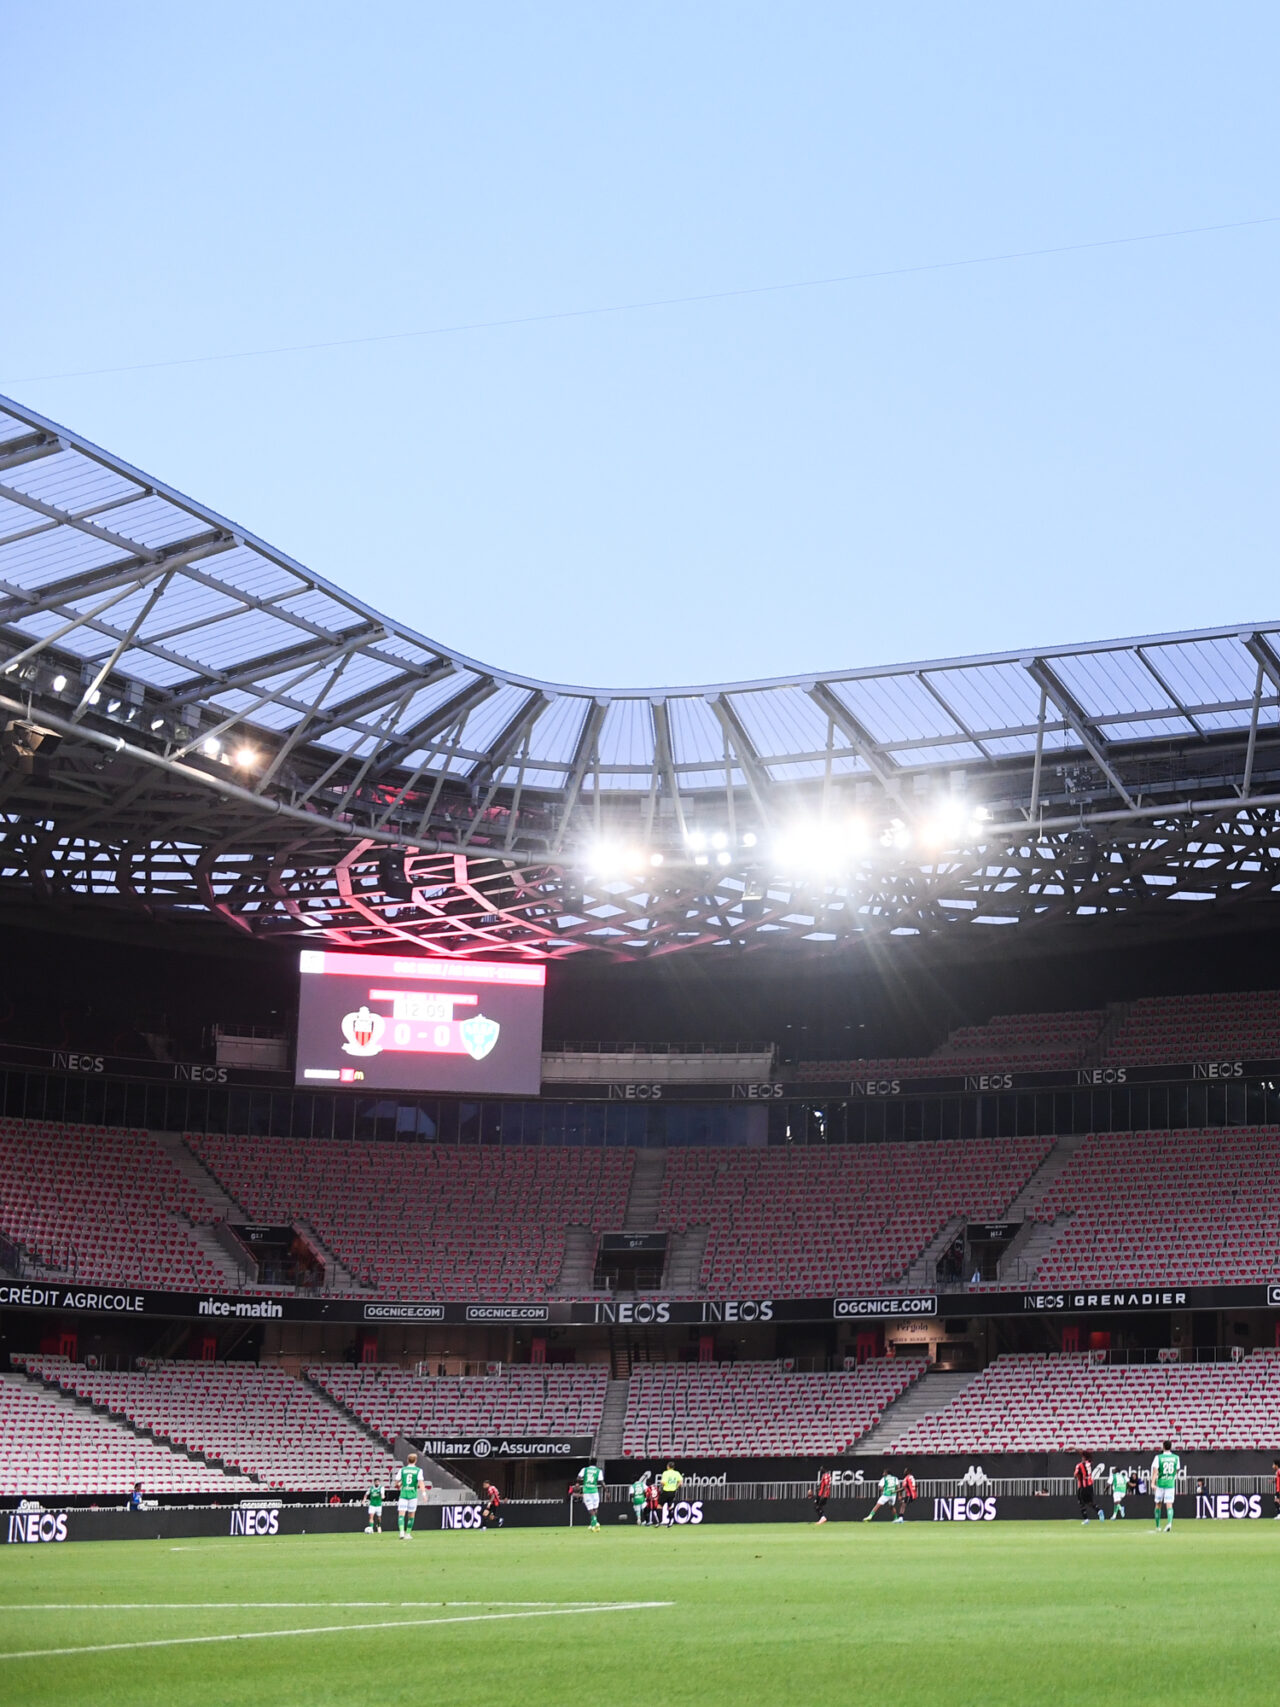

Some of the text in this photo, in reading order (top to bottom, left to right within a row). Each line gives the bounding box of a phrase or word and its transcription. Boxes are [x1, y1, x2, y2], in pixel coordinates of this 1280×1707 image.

[395, 1023, 410, 1044] 0
[434, 1025, 450, 1046] 0
[52, 1052, 104, 1073] INEOS
[1192, 1062, 1243, 1078] INEOS
[174, 1064, 228, 1083] INEOS
[964, 1074, 1013, 1090] INEOS
[1077, 1068, 1127, 1084] INEOS
[608, 1084, 661, 1101] INEOS
[731, 1083, 784, 1098] INEOS
[850, 1080, 900, 1095] INEOS
[0, 1286, 144, 1312] CRÉDIT AGRICOLE
[199, 1298, 283, 1318] nice-matin
[838, 1299, 932, 1313] OGCNICE.COM
[1024, 1292, 1186, 1309] INEOS GRENADIER
[368, 1306, 440, 1318] OGCNICE.COM
[470, 1307, 544, 1319] OGCNICE.COM
[595, 1302, 670, 1323] INEOS
[701, 1300, 773, 1321] INEOS
[423, 1441, 571, 1454] Allianz Assurance
[818, 1469, 864, 1485] IEOS
[934, 1497, 996, 1521] INEOS
[1196, 1495, 1262, 1519] INEOS
[230, 1510, 279, 1535] INEOS
[442, 1506, 482, 1529] INEOS
[8, 1514, 68, 1543] INEOS
